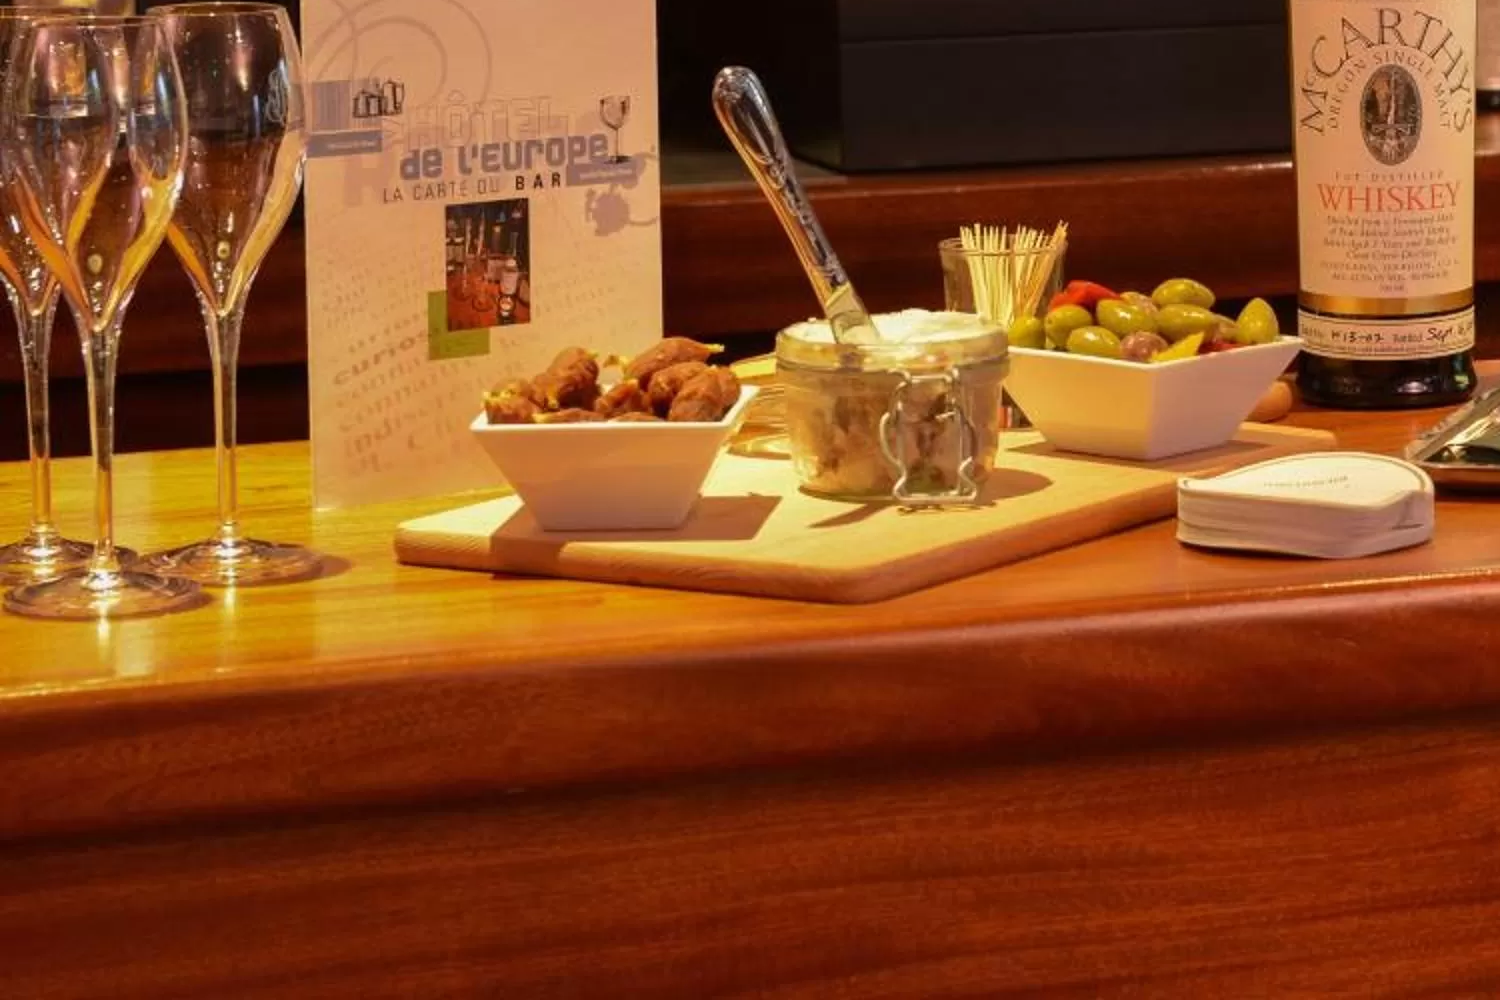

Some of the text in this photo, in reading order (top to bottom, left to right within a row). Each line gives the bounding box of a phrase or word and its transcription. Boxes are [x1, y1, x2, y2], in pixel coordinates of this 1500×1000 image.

[401, 148, 443, 180] de
[383, 188, 402, 204] LA
[412, 179, 468, 202] CARTE
[477, 177, 500, 195] DU
[515, 172, 561, 191] BAR
[1317, 181, 1461, 213] WHISKEY
